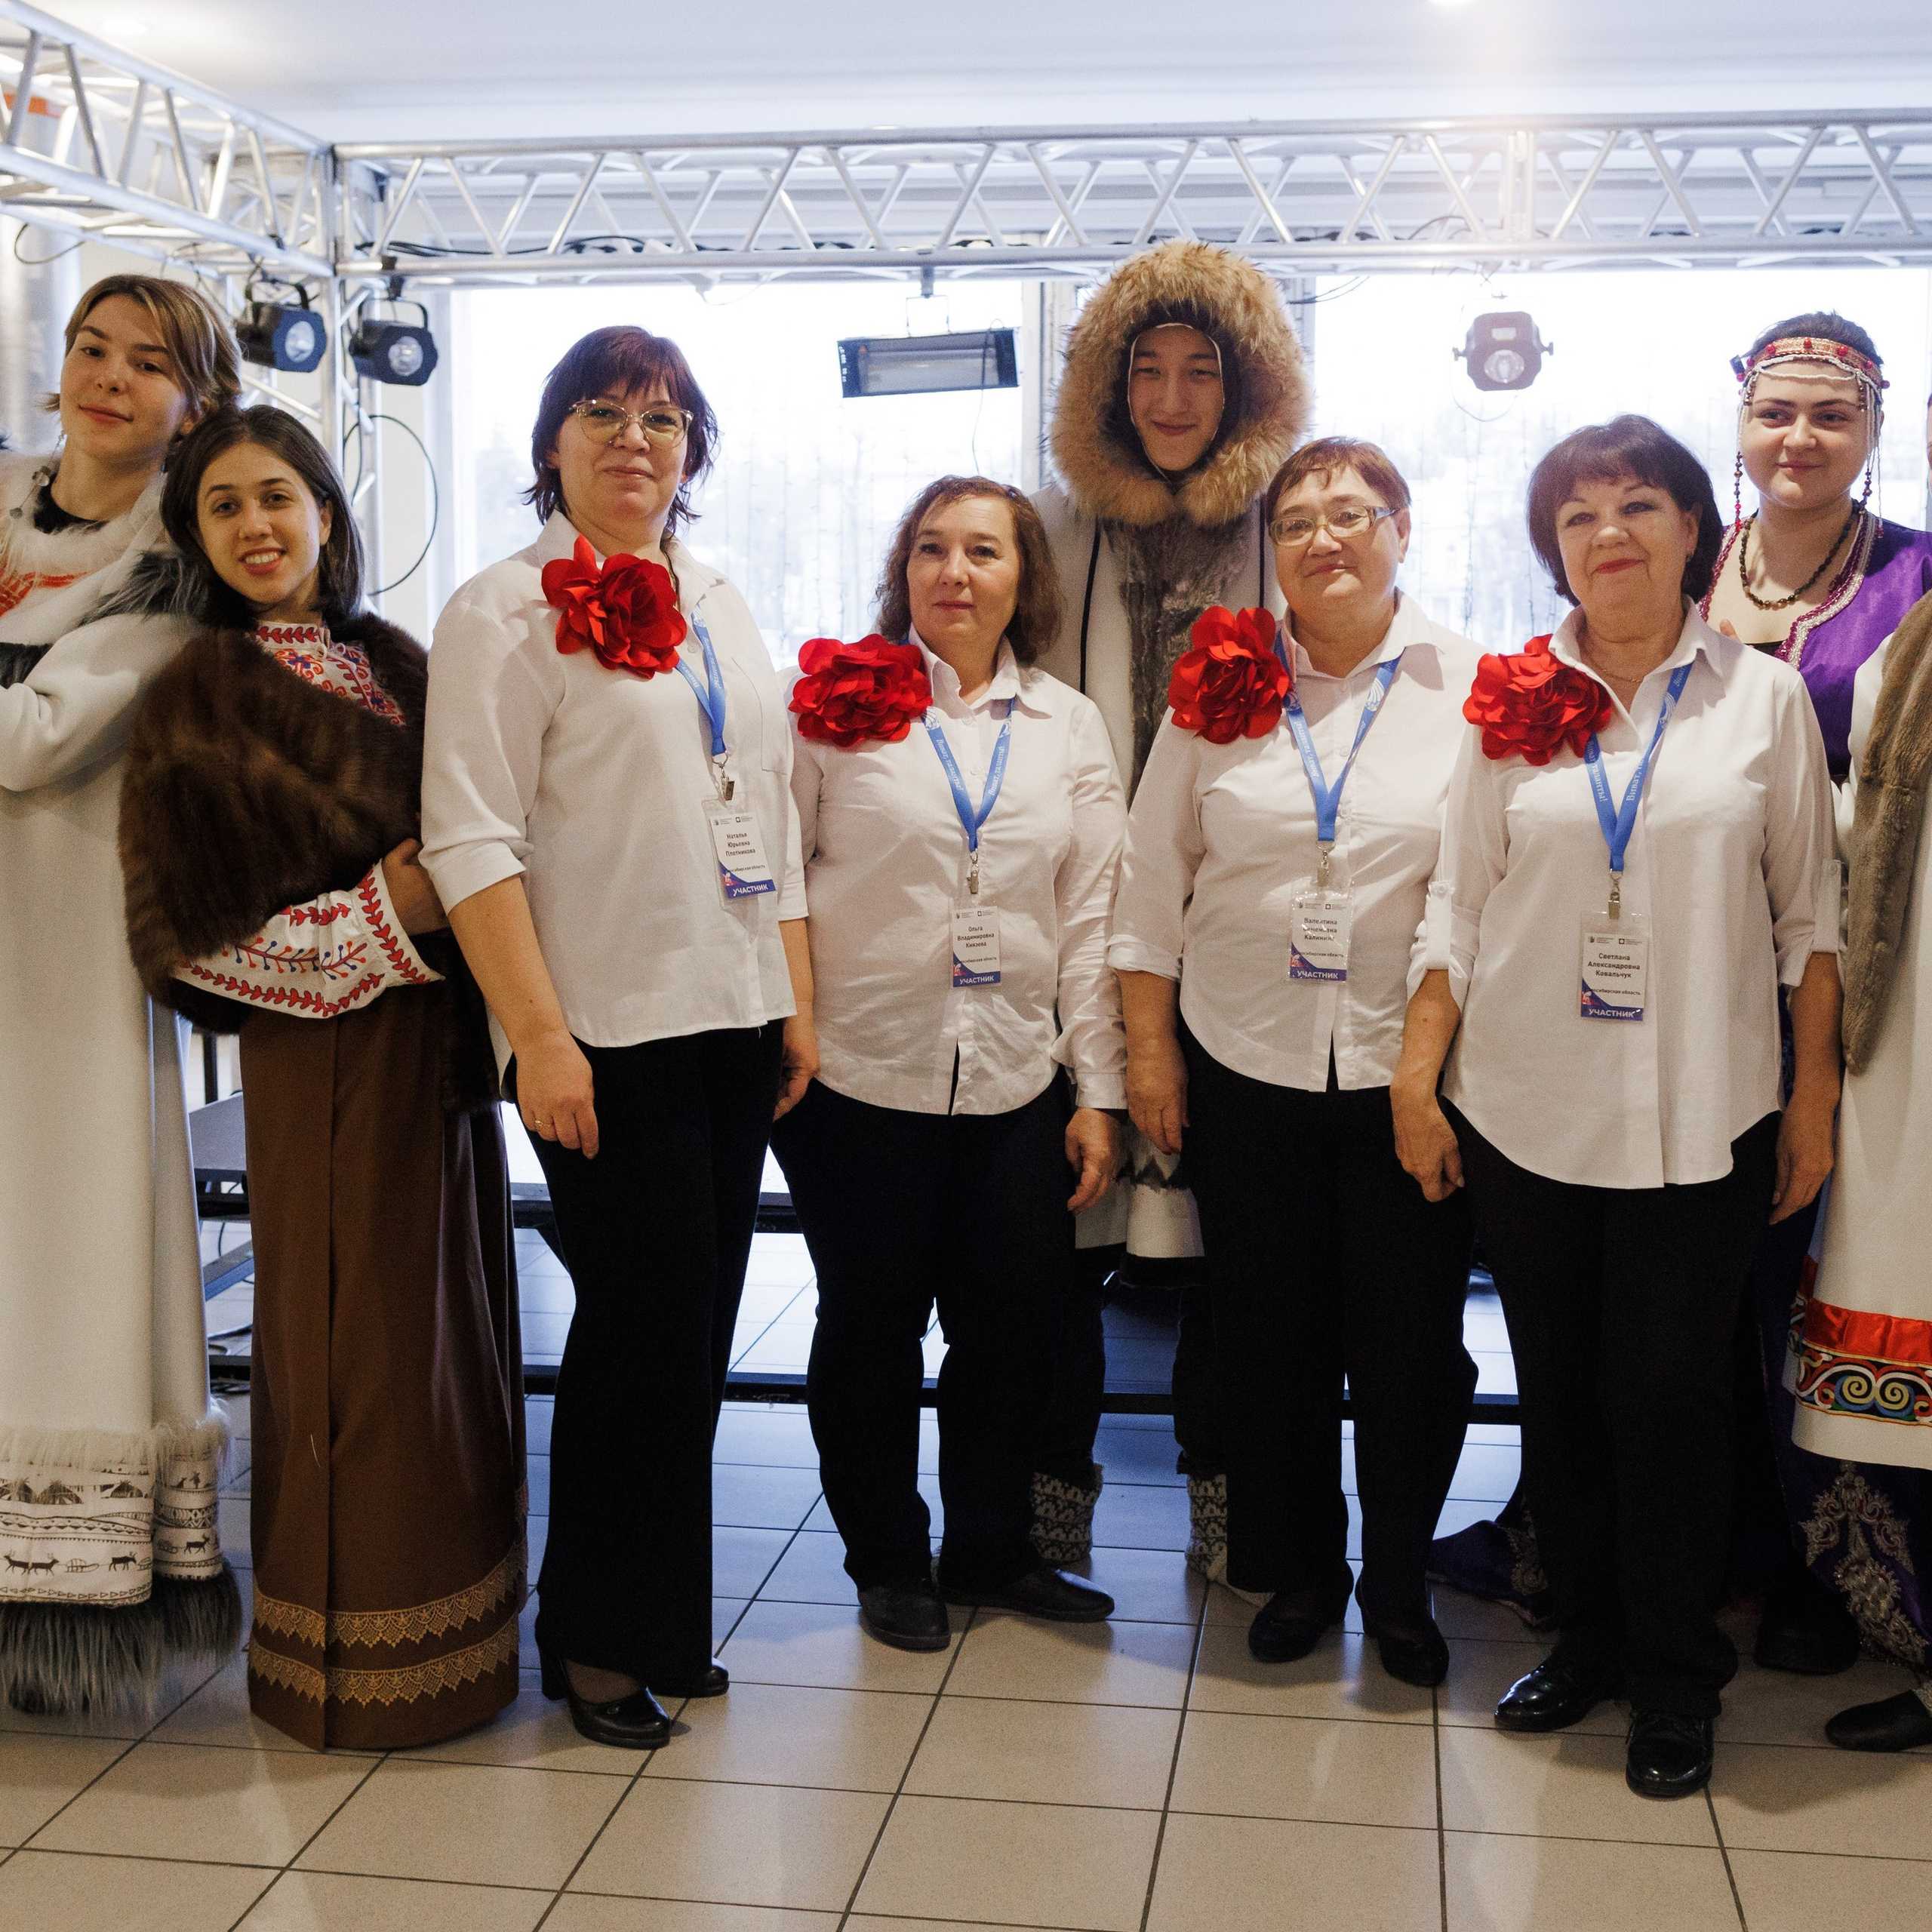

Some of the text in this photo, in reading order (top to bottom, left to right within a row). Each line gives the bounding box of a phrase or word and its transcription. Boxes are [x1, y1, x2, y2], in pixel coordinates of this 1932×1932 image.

[1294, 720, 1320, 777] Виват, таланты!
[936, 739, 964, 791] Виват, таланты!
[988, 746, 1005, 797] Виват, таланты!
[1592, 764, 1608, 802] таланты!
[1626, 771, 1643, 801] Виват,
[728, 840, 750, 848] Юрьевна
[725, 848, 755, 857] Плотникова
[732, 884, 769, 897] УЧАСТНИК
[957, 933, 995, 941] Владимировна
[1598, 952, 1631, 961] Светлана
[1588, 961, 1641, 971] Александровна
[1297, 971, 1338, 980] УЧАСТНИК
[1595, 970, 1632, 979] Ковальчук
[959, 975, 995, 985] УЧАСТНИК
[1588, 1008, 1634, 1018] УЧАСТНИК
